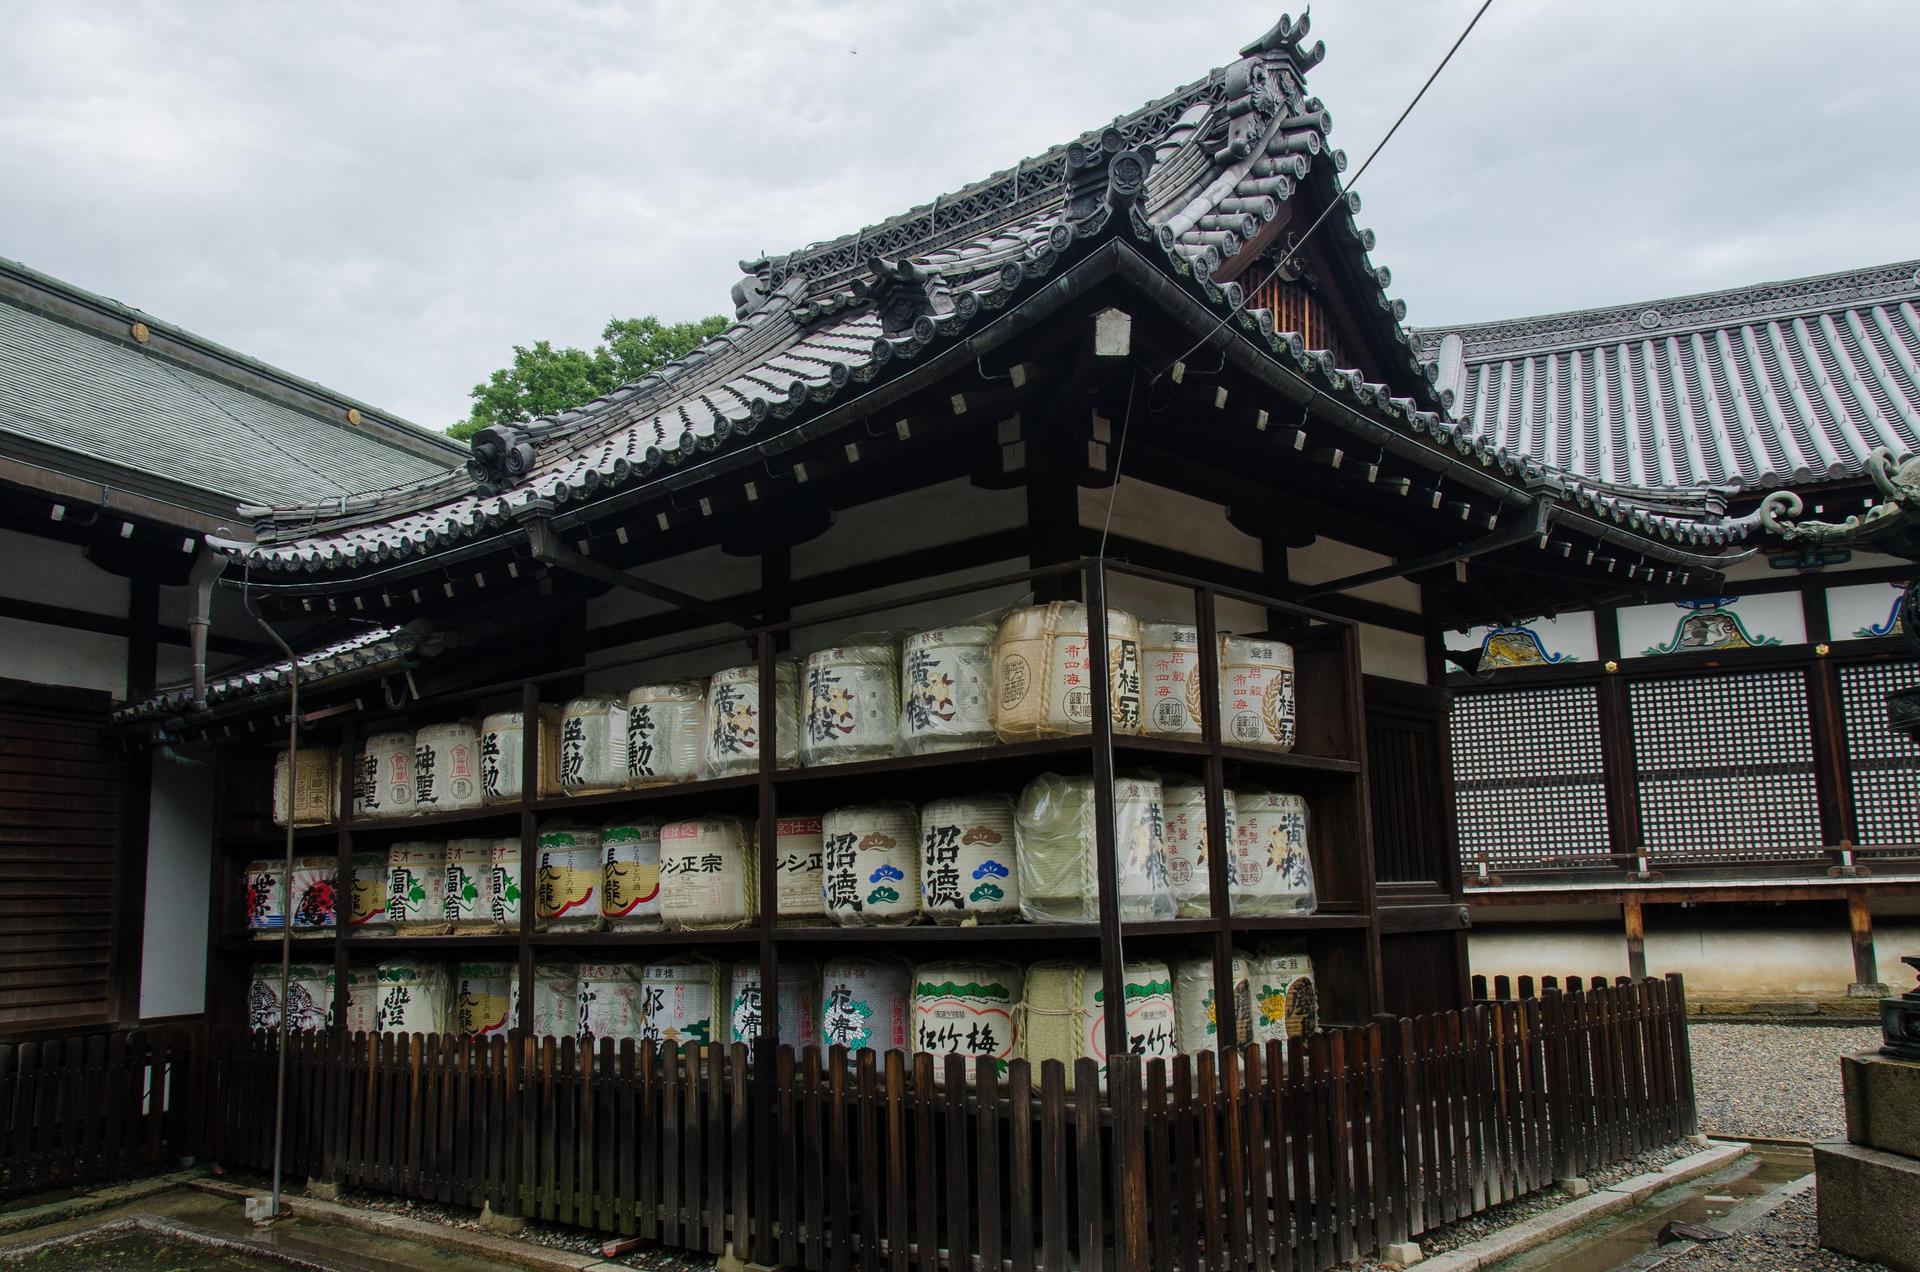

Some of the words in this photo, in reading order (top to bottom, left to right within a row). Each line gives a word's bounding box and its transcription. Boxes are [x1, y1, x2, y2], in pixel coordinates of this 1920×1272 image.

[1117, 640, 1140, 729] 月桂冠
[919, 1018, 1000, 1055] 松竹梅
